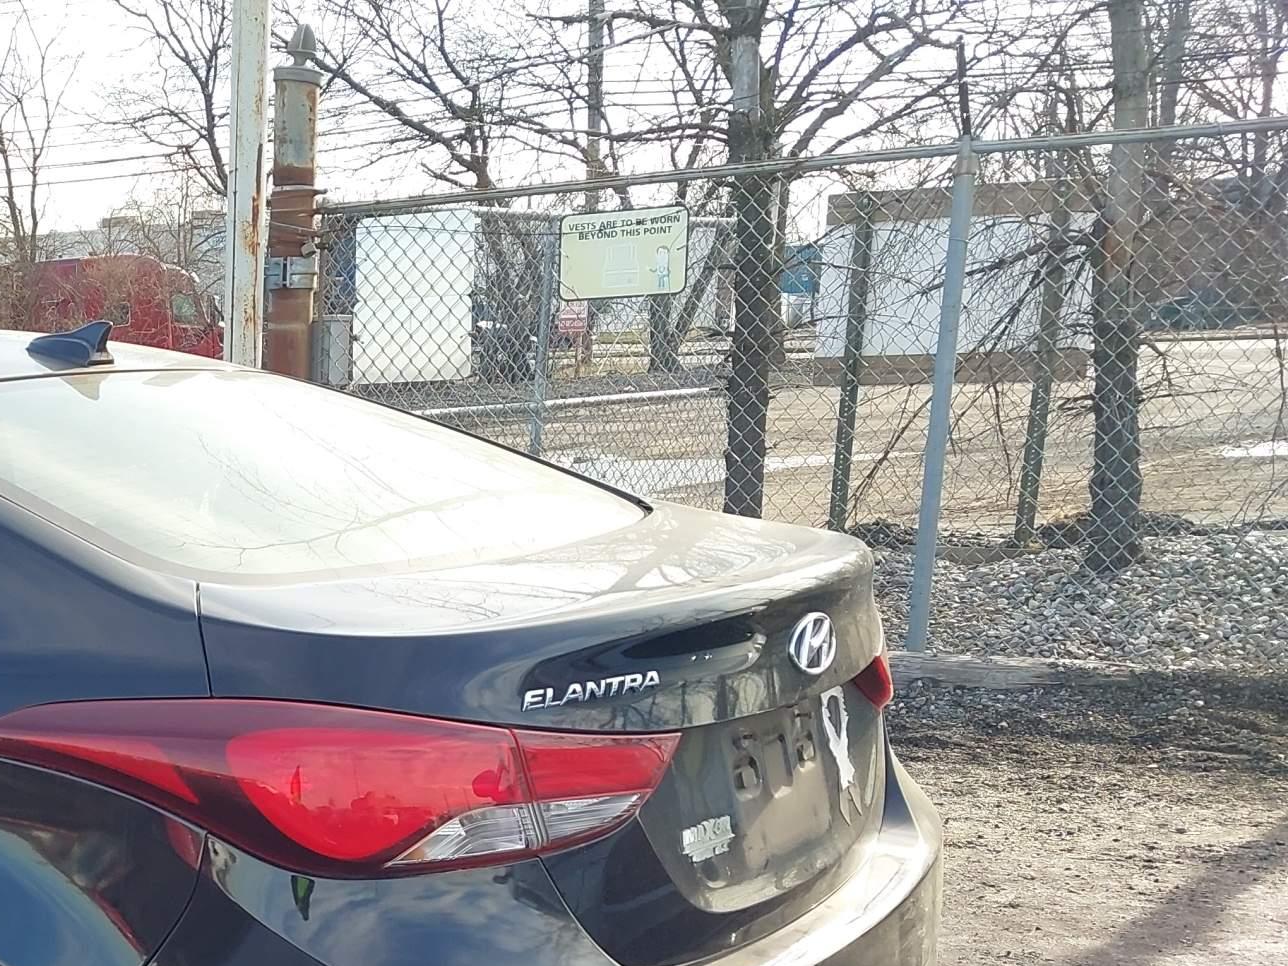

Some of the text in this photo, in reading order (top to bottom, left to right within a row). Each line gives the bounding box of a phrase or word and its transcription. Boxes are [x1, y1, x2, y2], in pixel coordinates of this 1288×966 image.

[568, 215, 680, 231] VESTS ARE TO BE WORN
[578, 225, 673, 240] BEYOND THIS POINT
[522, 670, 660, 712] ELANTRA
